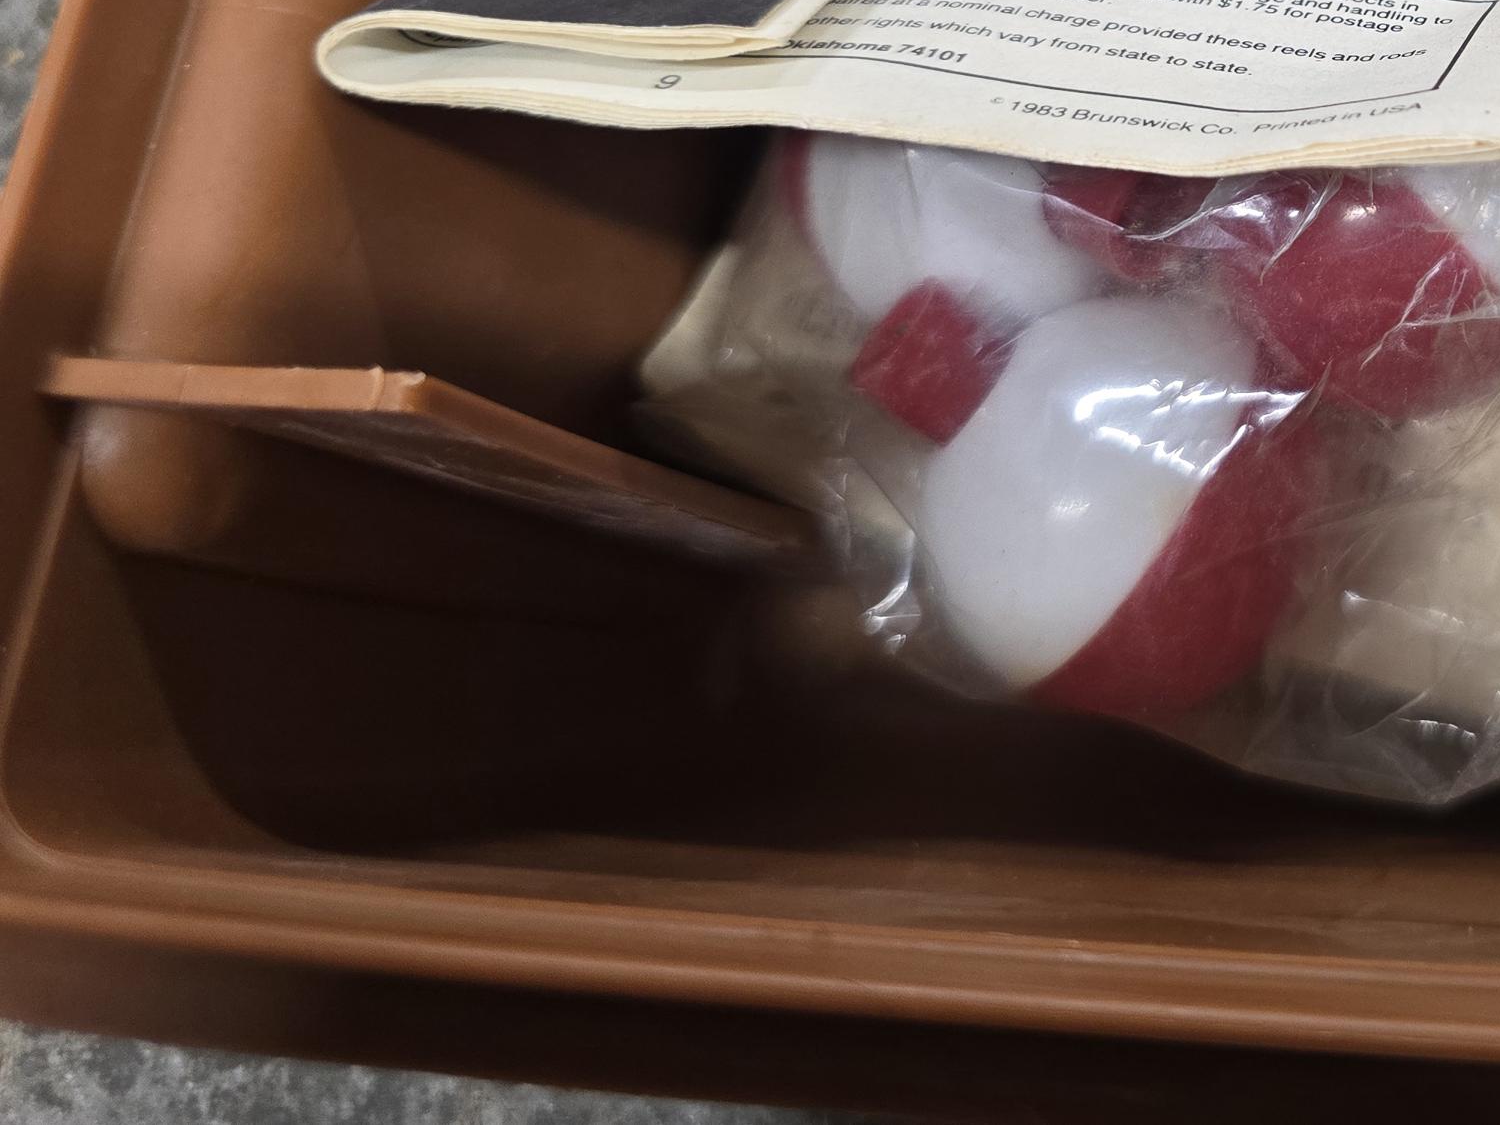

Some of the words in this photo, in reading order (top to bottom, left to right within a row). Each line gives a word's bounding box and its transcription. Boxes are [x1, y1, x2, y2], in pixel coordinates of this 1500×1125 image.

[1282, 5, 1313, 21] for
[1314, 12, 1405, 35] postage
[1336, 0, 1428, 28] handling
[1433, 15, 1456, 27] to
[805, 16, 861, 27] other
[863, 17, 924, 30] rights
[929, 20, 993, 38] which
[999, 30, 1048, 48] vary
[1048, 36, 1101, 56] from
[1103, 46, 1161, 65] state
[1164, 55, 1188, 68] to
[1191, 60, 1253, 76] state.
[934, 0, 1023, 17] nominal
[1024, 9, 1101, 29] charge
[1102, 20, 1204, 45] provided
[1205, 33, 1267, 52] these
[1270, 43, 1327, 62] reels
[1331, 53, 1376, 64] and
[1378, 47, 1428, 62] rods
[896, 43, 970, 64] 74101
[654, 74, 682, 90] 9
[1010, 100, 1068, 119] 1983
[1070, 109, 1195, 134] Brunswick
[1199, 122, 1239, 138] Co.
[1252, 115, 1338, 135] Printed
[1340, 112, 1364, 123] in
[1368, 101, 1424, 119] USA
